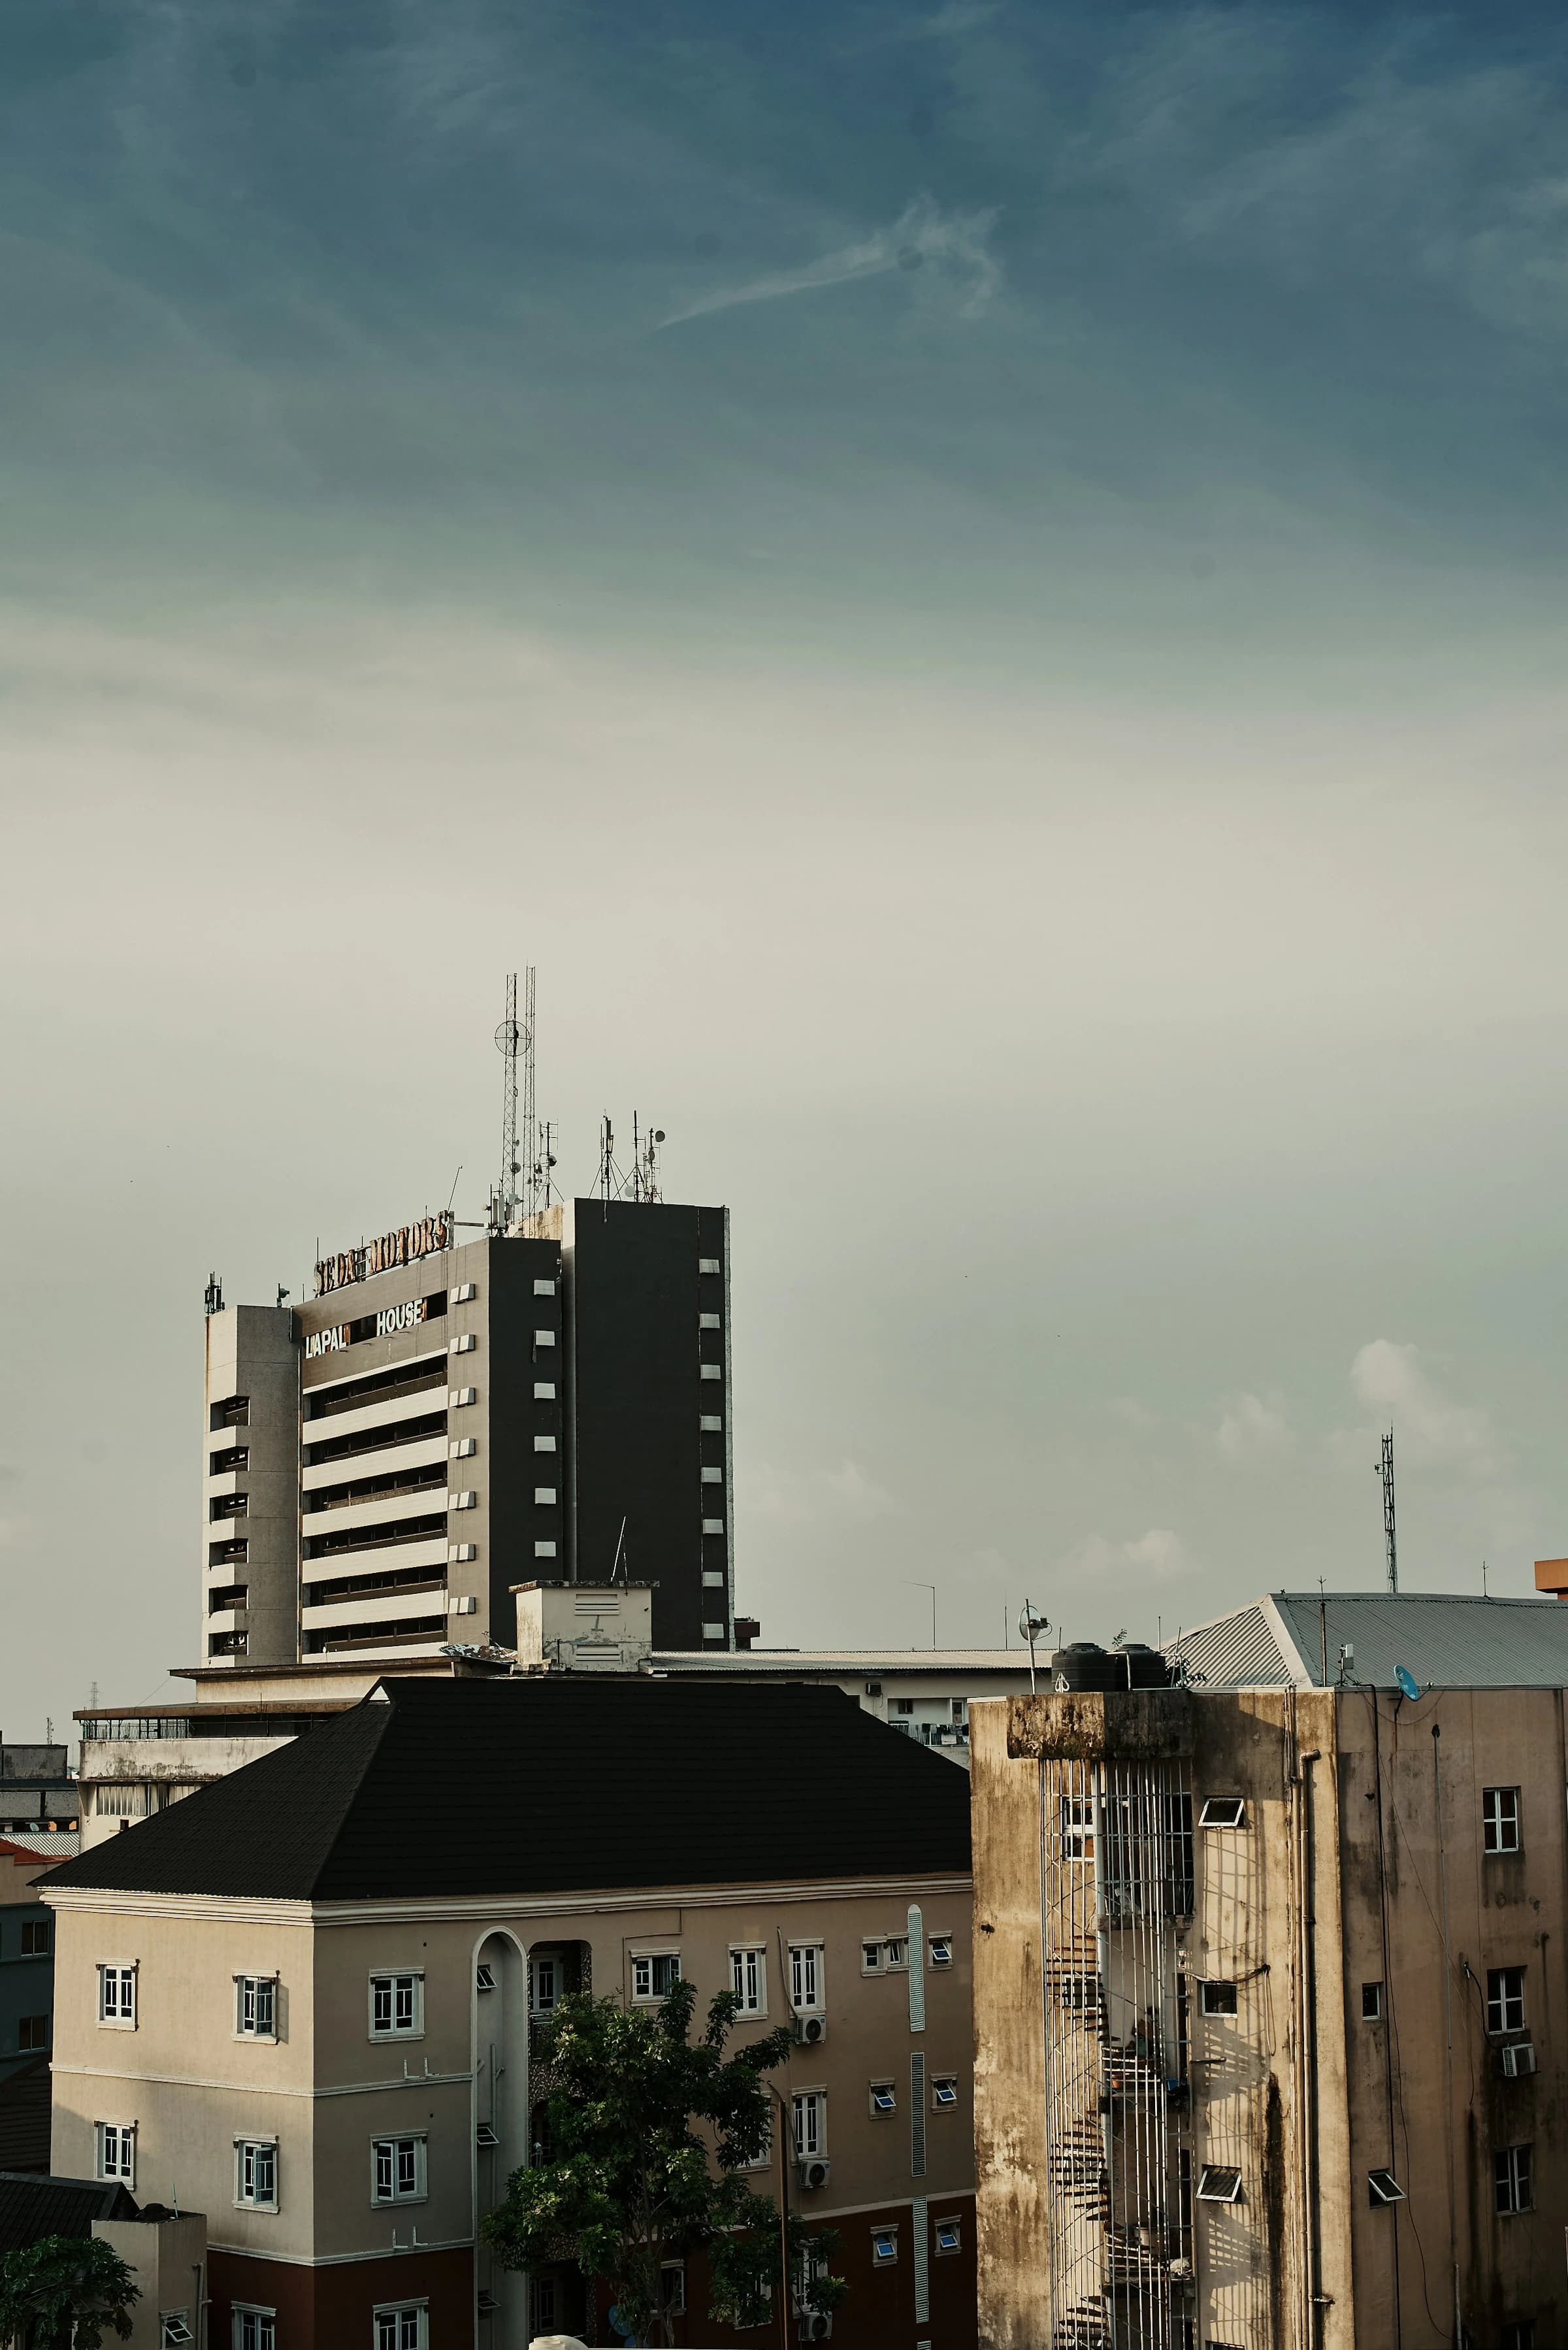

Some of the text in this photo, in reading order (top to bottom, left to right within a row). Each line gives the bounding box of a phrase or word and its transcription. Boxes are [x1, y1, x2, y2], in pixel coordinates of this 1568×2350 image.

[369, 1211, 448, 1274] MOTORS
[306, 1299, 423, 1359] LAPAL HOUSE
